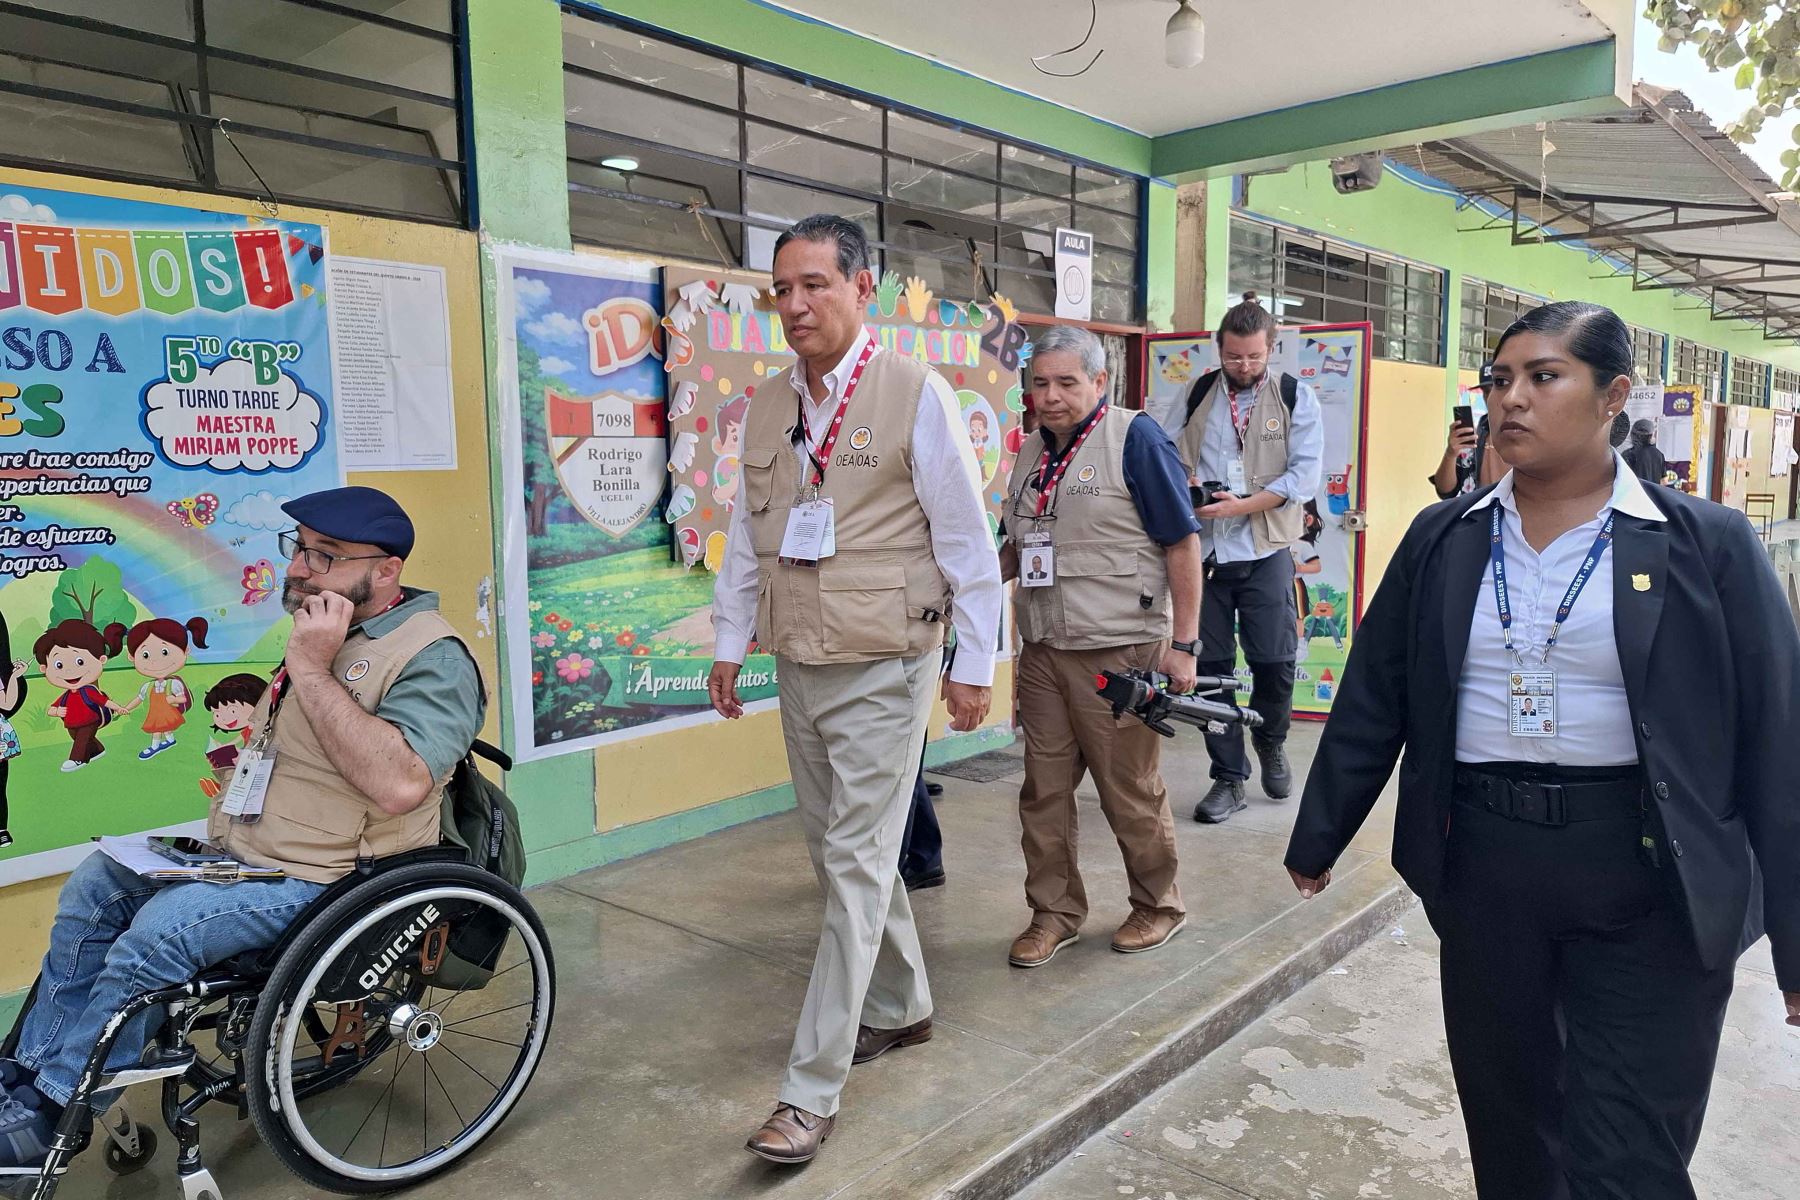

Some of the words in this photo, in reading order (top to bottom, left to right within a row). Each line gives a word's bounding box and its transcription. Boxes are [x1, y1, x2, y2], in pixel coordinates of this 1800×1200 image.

[1064, 237, 1085, 250] AULA
[711, 311, 766, 353] DIA
[770, 313, 794, 352] D
[864, 325, 980, 369] UCACION
[981, 304, 1026, 372] 2B
[0, 327, 74, 371] SO
[85, 333, 126, 373] A
[168, 337, 220, 384] 5TO
[176, 388, 228, 409] TURNO
[232, 390, 281, 410] TARDE
[196, 415, 276, 434] MAESTRA
[597, 413, 632, 428] 7098
[174, 437, 240, 456] MIRIAM
[247, 437, 299, 456] POPPE
[588, 448, 643, 462] Rodrigo
[0, 454, 24, 468] re
[29, 451, 72, 468] trae
[76, 450, 152, 472] consigo
[600, 464, 632, 476] Lara
[114, 478, 149, 496] que
[593, 479, 640, 492] Bonilla
[26, 526, 114, 549] esfuerzo,
[0, 556, 65, 577] ogros.
[1563, 573, 1585, 607] DIRSEEST
[1583, 556, 1594, 571] PNP
[1498, 580, 1507, 613] DIRSEEST
[626, 663, 709, 698] ¡Aprende
[734, 669, 769, 688] ntos
[359, 904, 441, 990] QUICKIE
